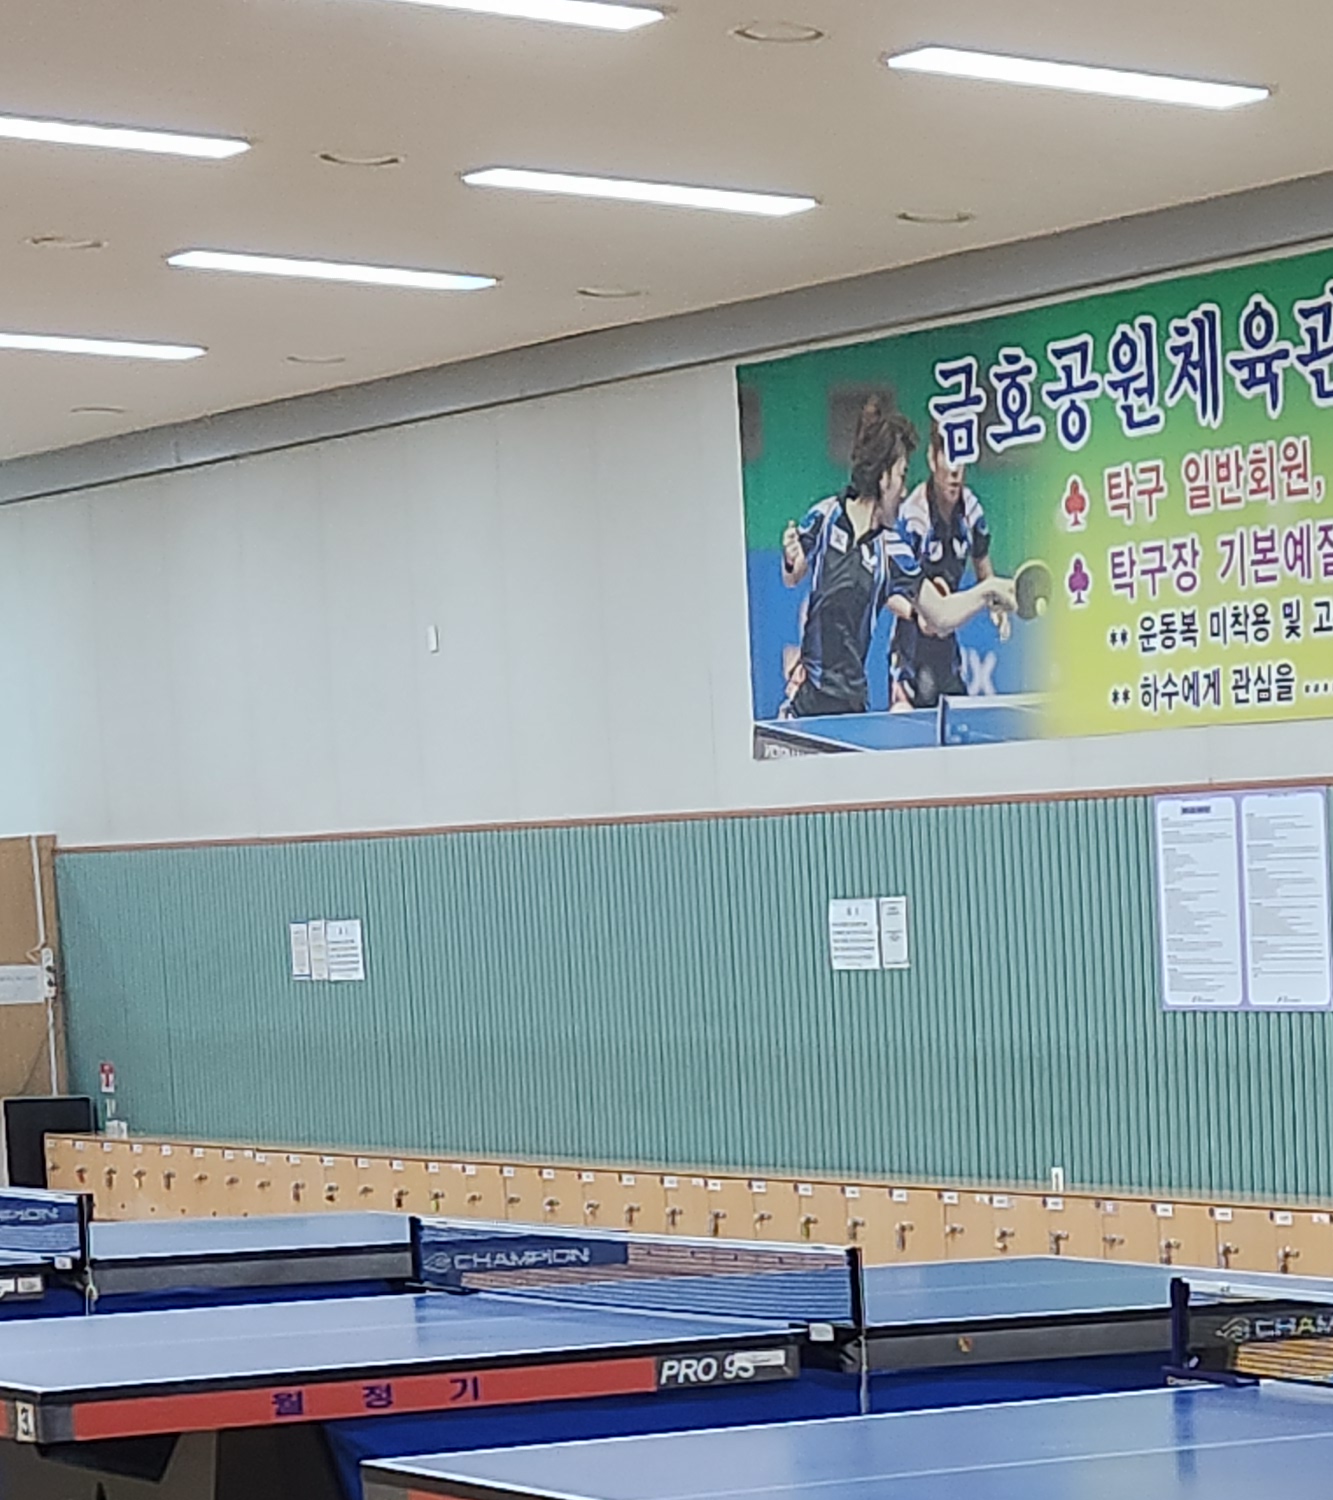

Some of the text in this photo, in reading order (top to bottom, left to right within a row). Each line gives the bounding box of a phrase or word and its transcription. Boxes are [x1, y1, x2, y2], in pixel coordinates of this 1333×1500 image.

[1106, 465, 1166, 519] 탁구
[1183, 440, 1323, 510] 일반회원,
[1110, 538, 1200, 598] 탁구장
[1138, 609, 1199, 652] 운동복
[1209, 603, 1271, 645] 미착용
[1281, 598, 1302, 639] 및
[1140, 667, 1222, 711] 하수에게
[453, 1246, 591, 1271] CHAMPION
[660, 1357, 718, 1385] PRO
[20, 1406, 32, 1436] 3
